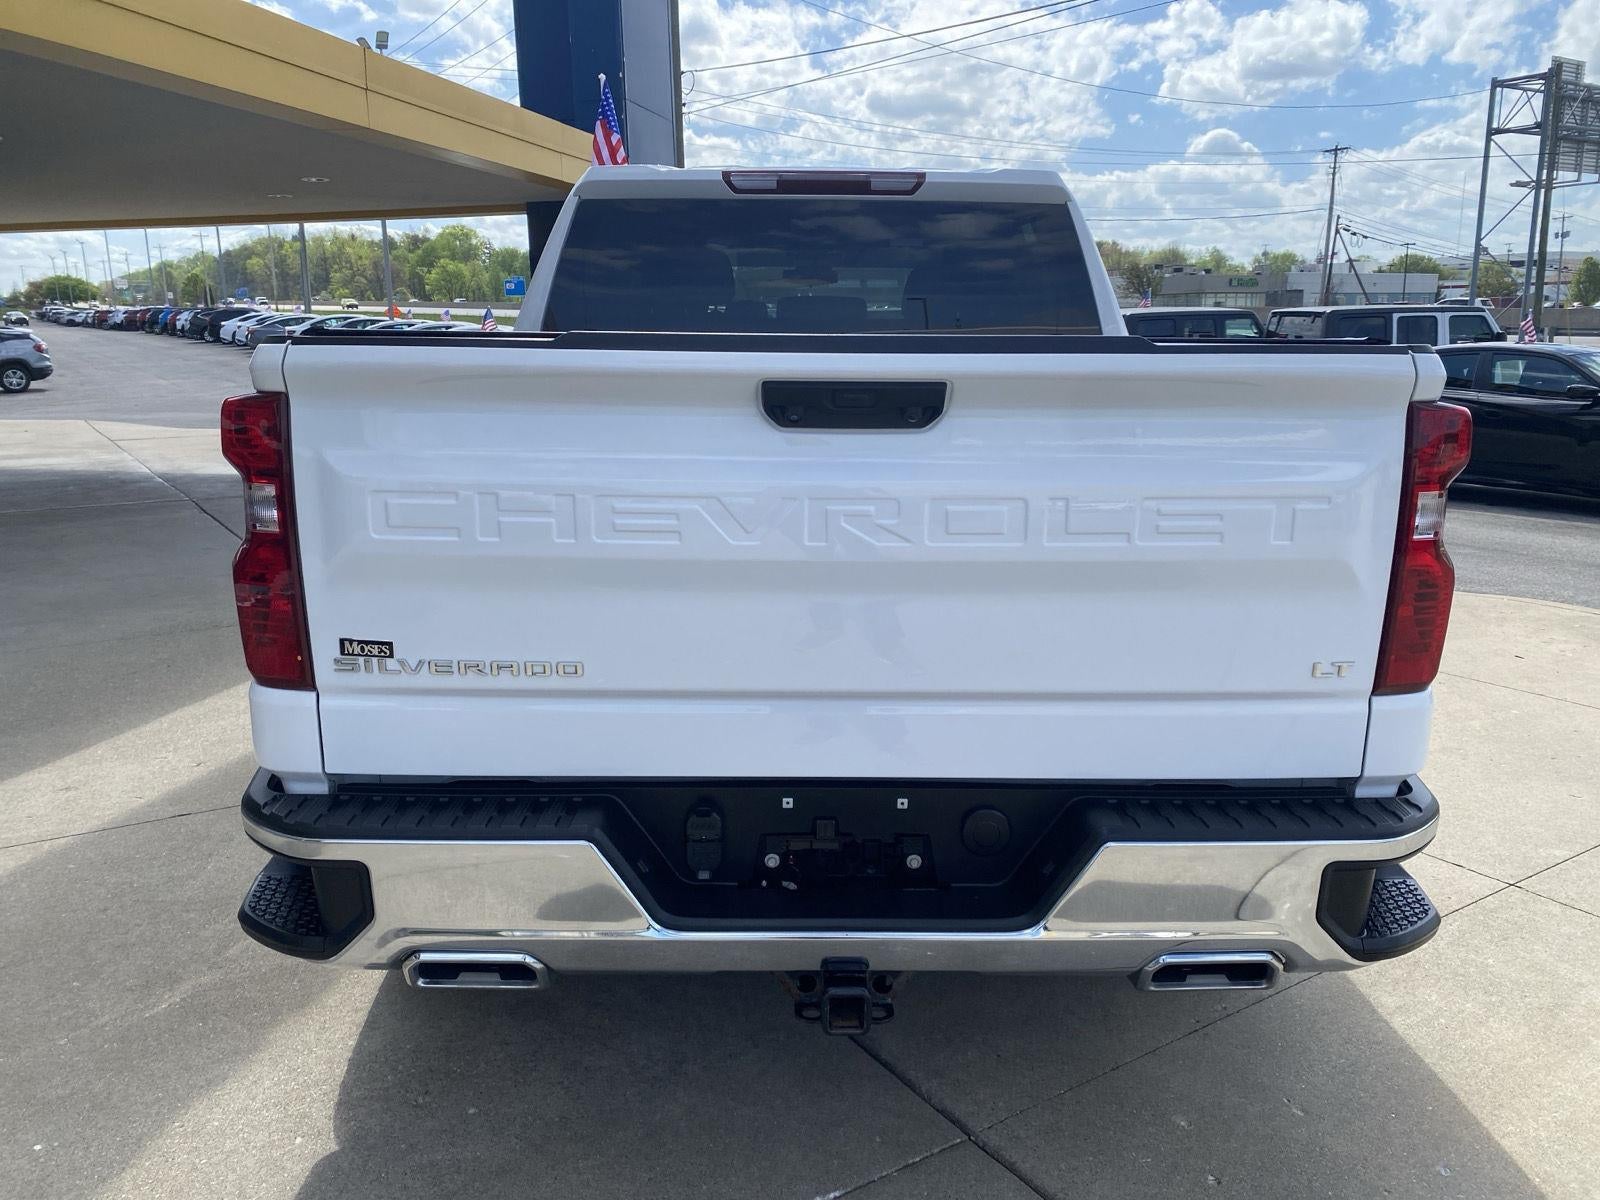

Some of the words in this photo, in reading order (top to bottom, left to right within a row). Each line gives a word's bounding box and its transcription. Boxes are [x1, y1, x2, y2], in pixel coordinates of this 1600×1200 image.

[367, 489, 1332, 547] CHEVROLET
[333, 657, 585, 678] SILVERADO
[1311, 661, 1356, 678] LT
